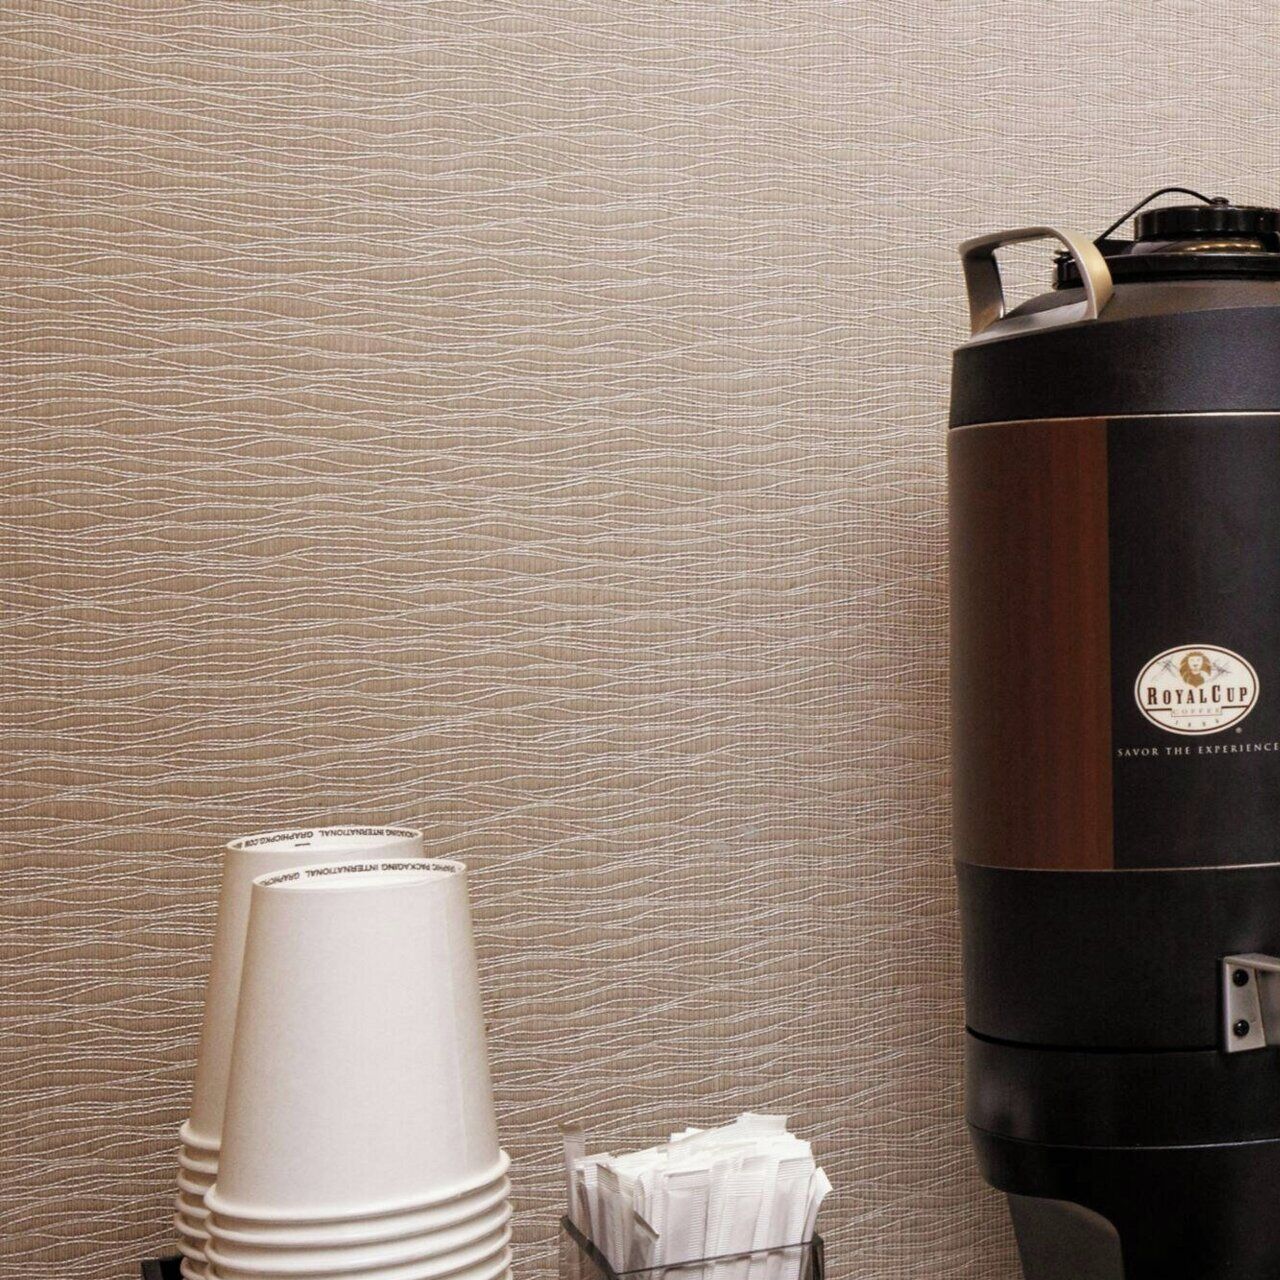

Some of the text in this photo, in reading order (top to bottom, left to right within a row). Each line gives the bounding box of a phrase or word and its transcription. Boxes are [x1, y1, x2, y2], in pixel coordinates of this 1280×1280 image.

[1117, 742, 1280, 757] SAVOR THE EXPERIENCE
[319, 828, 384, 838] INTERNATIONAL
[304, 864, 379, 878] INTERNATIONAL
[381, 863, 431, 872] PACKAGING
